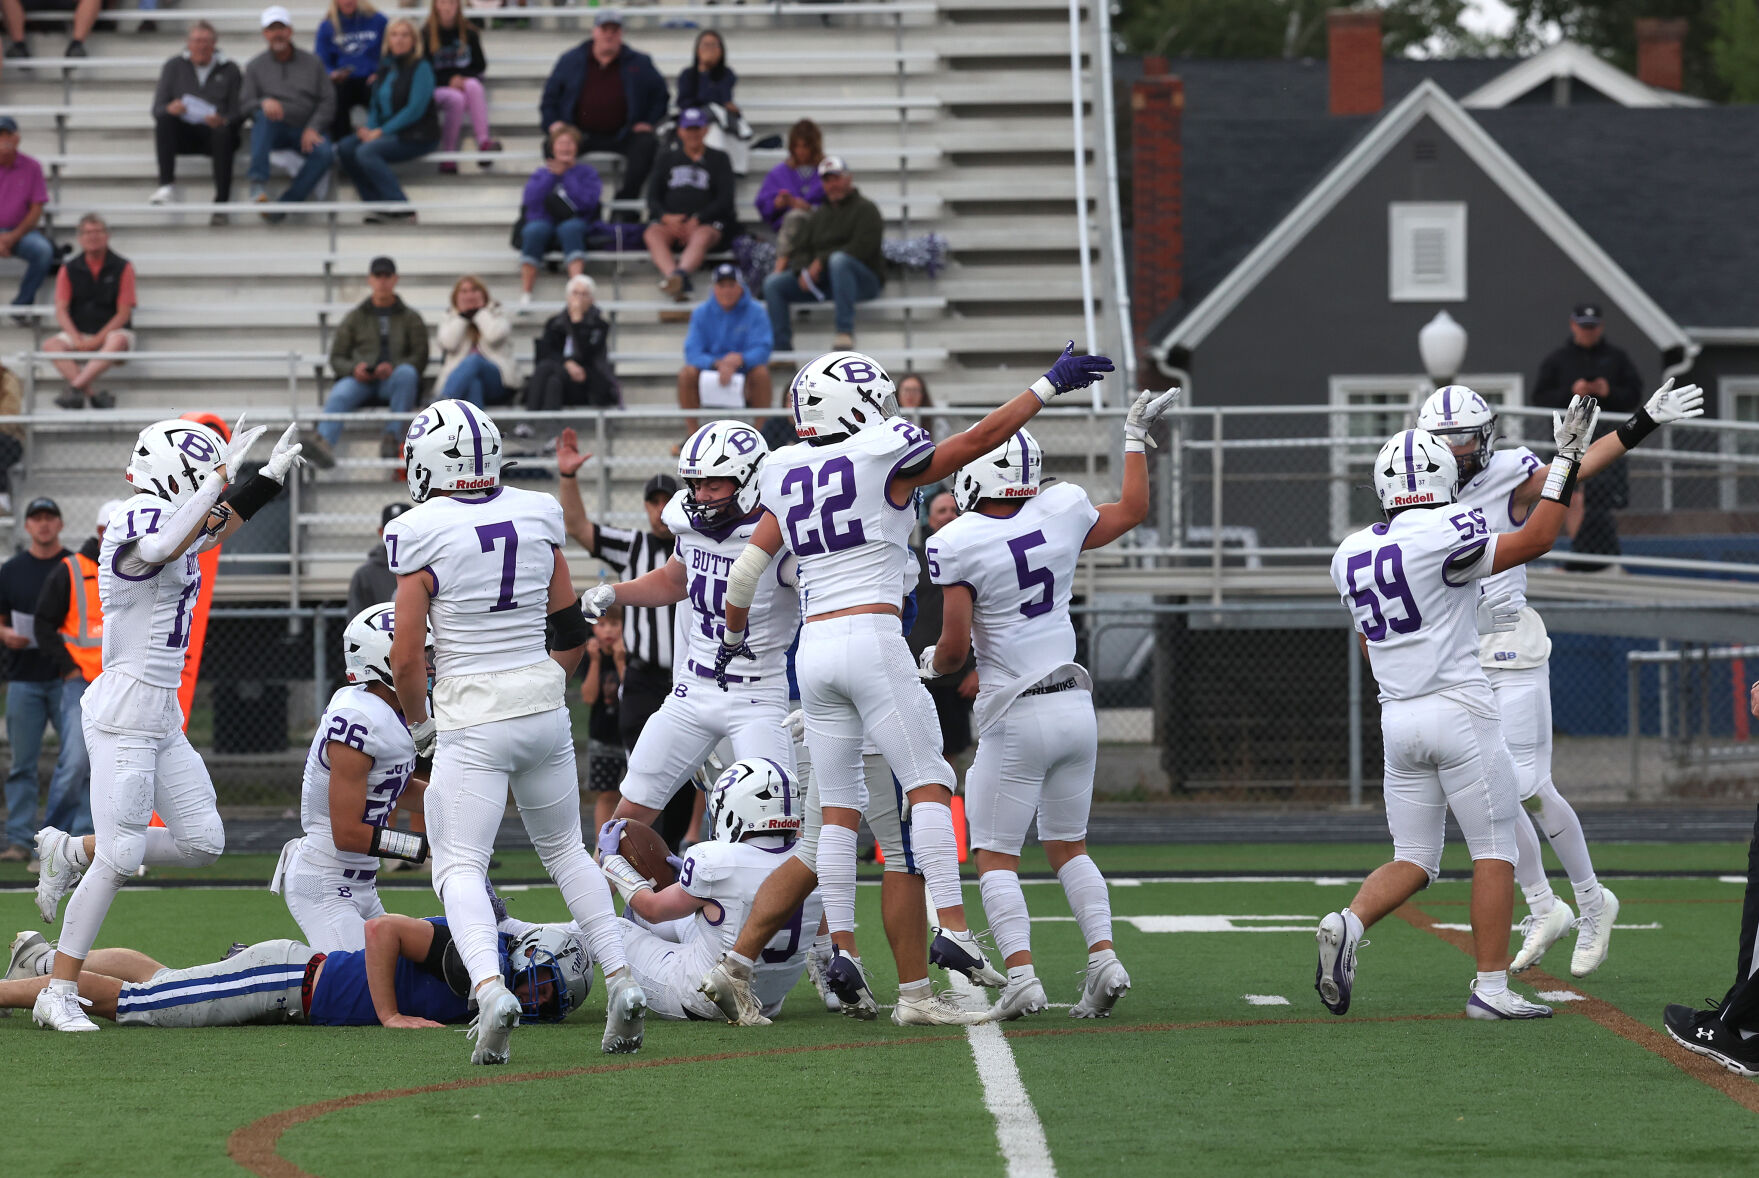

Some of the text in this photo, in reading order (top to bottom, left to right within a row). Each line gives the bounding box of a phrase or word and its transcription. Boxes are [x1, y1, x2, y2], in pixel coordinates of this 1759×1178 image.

[838, 361, 877, 383] B
[407, 414, 430, 440] B
[177, 431, 215, 462] B
[727, 430, 758, 456] B
[1521, 453, 1541, 477] 2
[455, 477, 496, 490] Riddell
[1004, 486, 1039, 497] Riddell
[780, 455, 868, 557] 22
[1394, 492, 1435, 506] Riddell
[126, 508, 162, 539] 17
[385, 534, 399, 568] 7
[691, 548, 736, 577] BUTT
[926, 547, 941, 578] 5
[475, 520, 519, 613] 7
[1007, 529, 1055, 619] 5
[1346, 542, 1423, 642] 59
[674, 683, 689, 698] B
[326, 715, 369, 752] 26
[713, 768, 739, 793] B
[773, 785, 779, 794] 9
[768, 819, 801, 829] Riddel
[681, 856, 696, 888] 9
[336, 885, 353, 899] B
